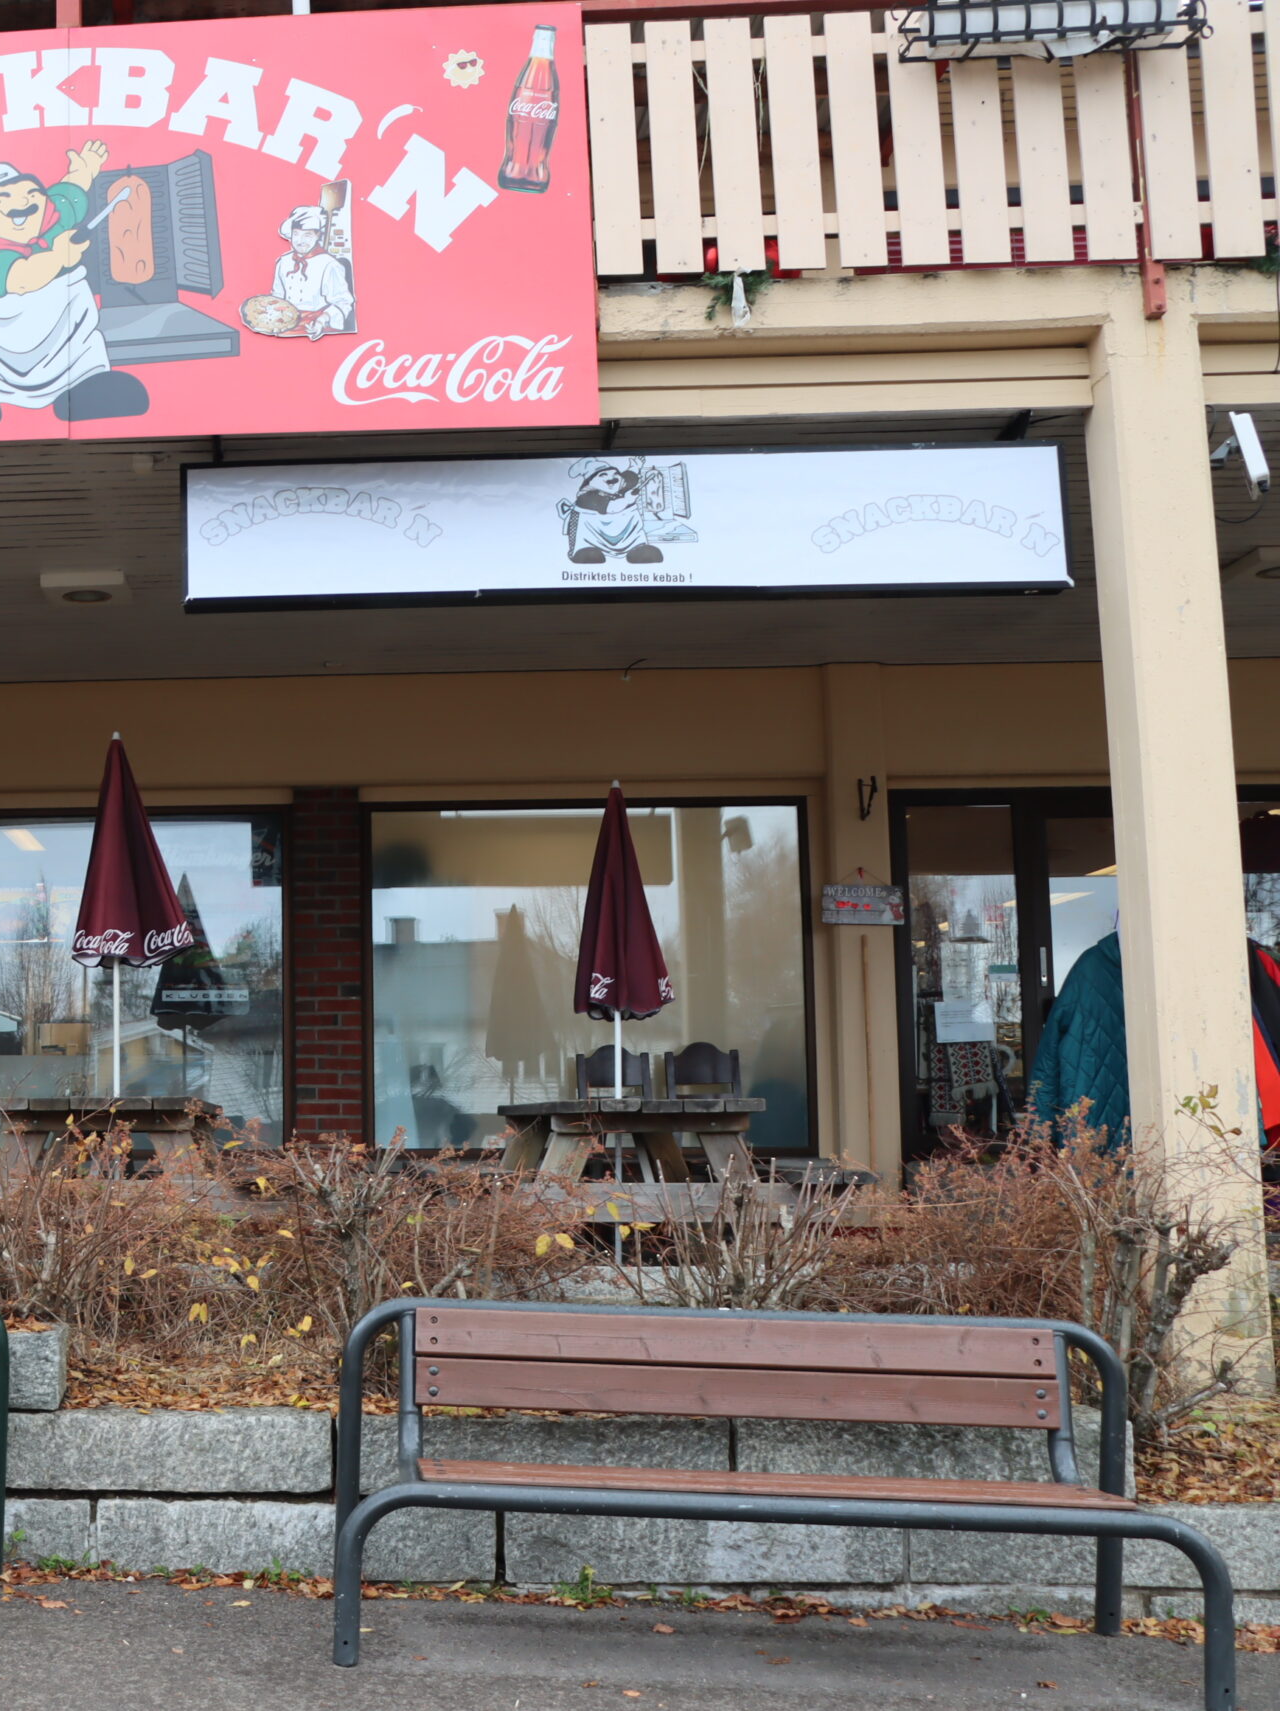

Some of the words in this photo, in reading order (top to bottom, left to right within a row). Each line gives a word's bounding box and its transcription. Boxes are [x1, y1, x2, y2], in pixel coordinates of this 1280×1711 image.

[509, 97, 558, 120] Coca-Cola
[332, 334, 573, 405] Coca-Cola
[561, 571, 617, 582] Distriktets
[620, 572, 650, 582] beste
[653, 573, 685, 583] kebab
[827, 887, 882, 897] WELCOME
